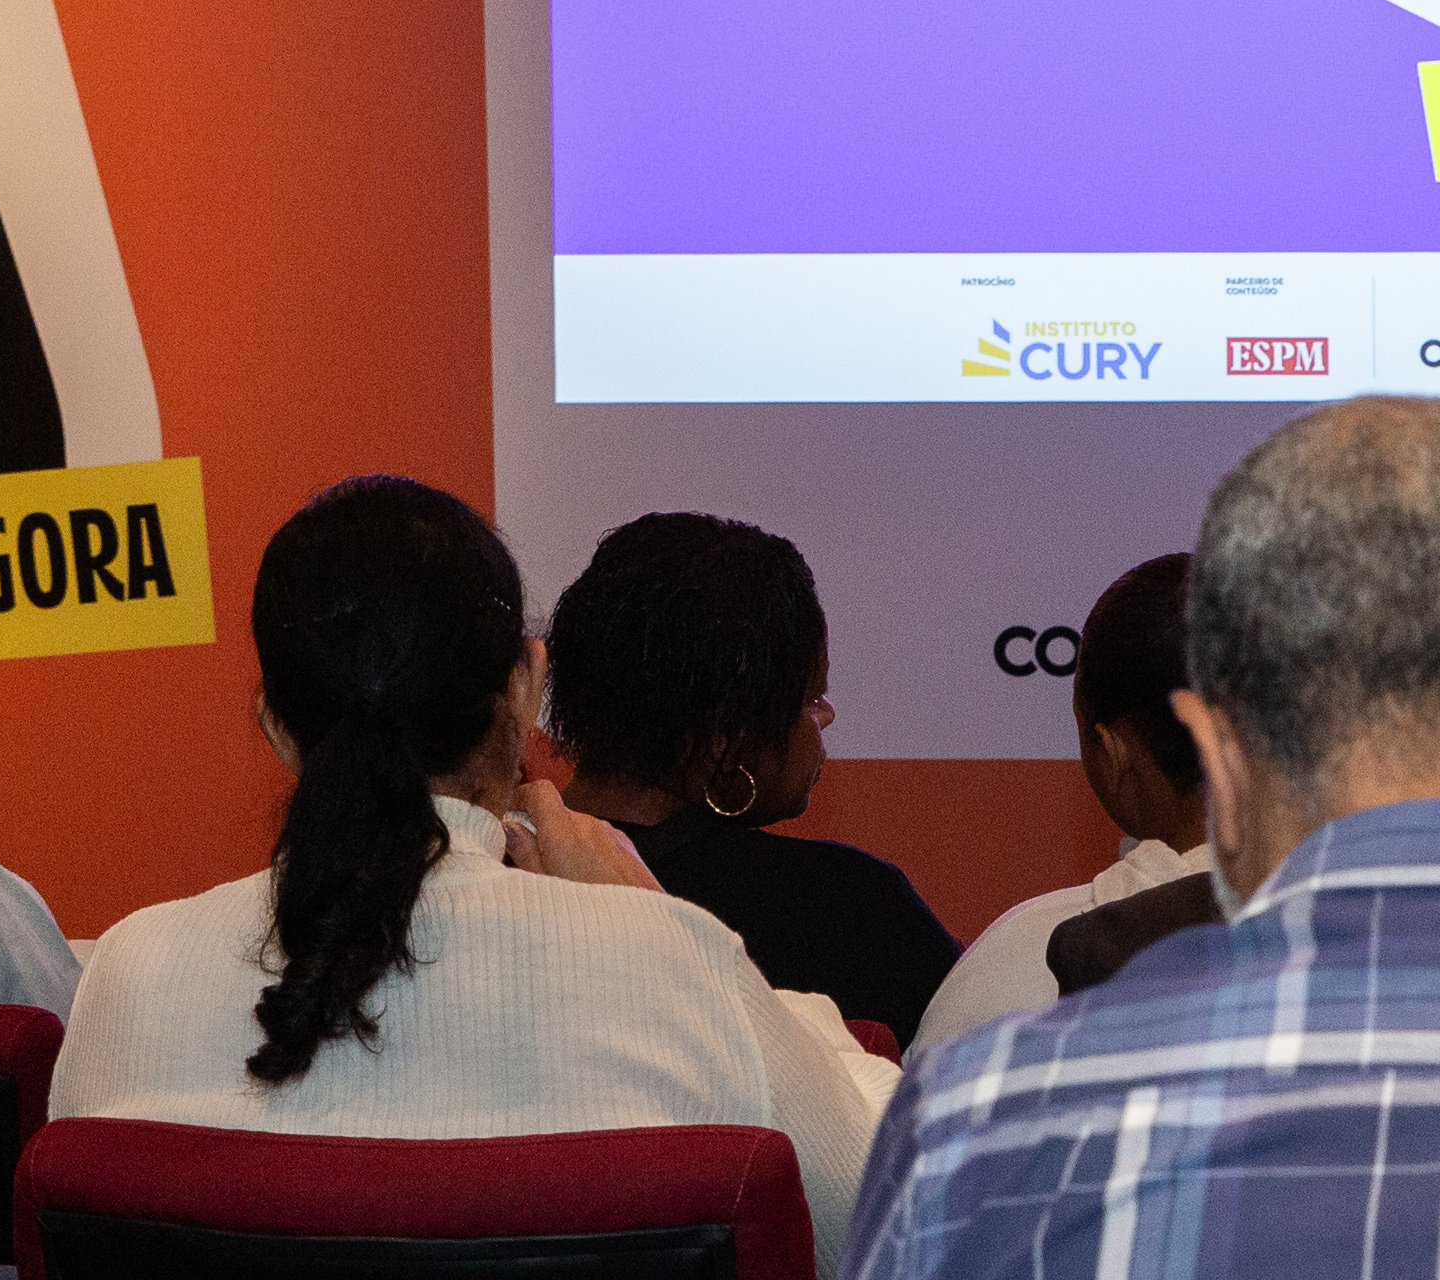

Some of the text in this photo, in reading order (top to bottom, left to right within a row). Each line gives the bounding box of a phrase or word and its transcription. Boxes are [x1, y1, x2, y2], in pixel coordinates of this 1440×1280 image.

[1024, 321, 1138, 337] INSTITUTO
[1018, 342, 1165, 381] CURY
[1230, 340, 1326, 373] ESPM
